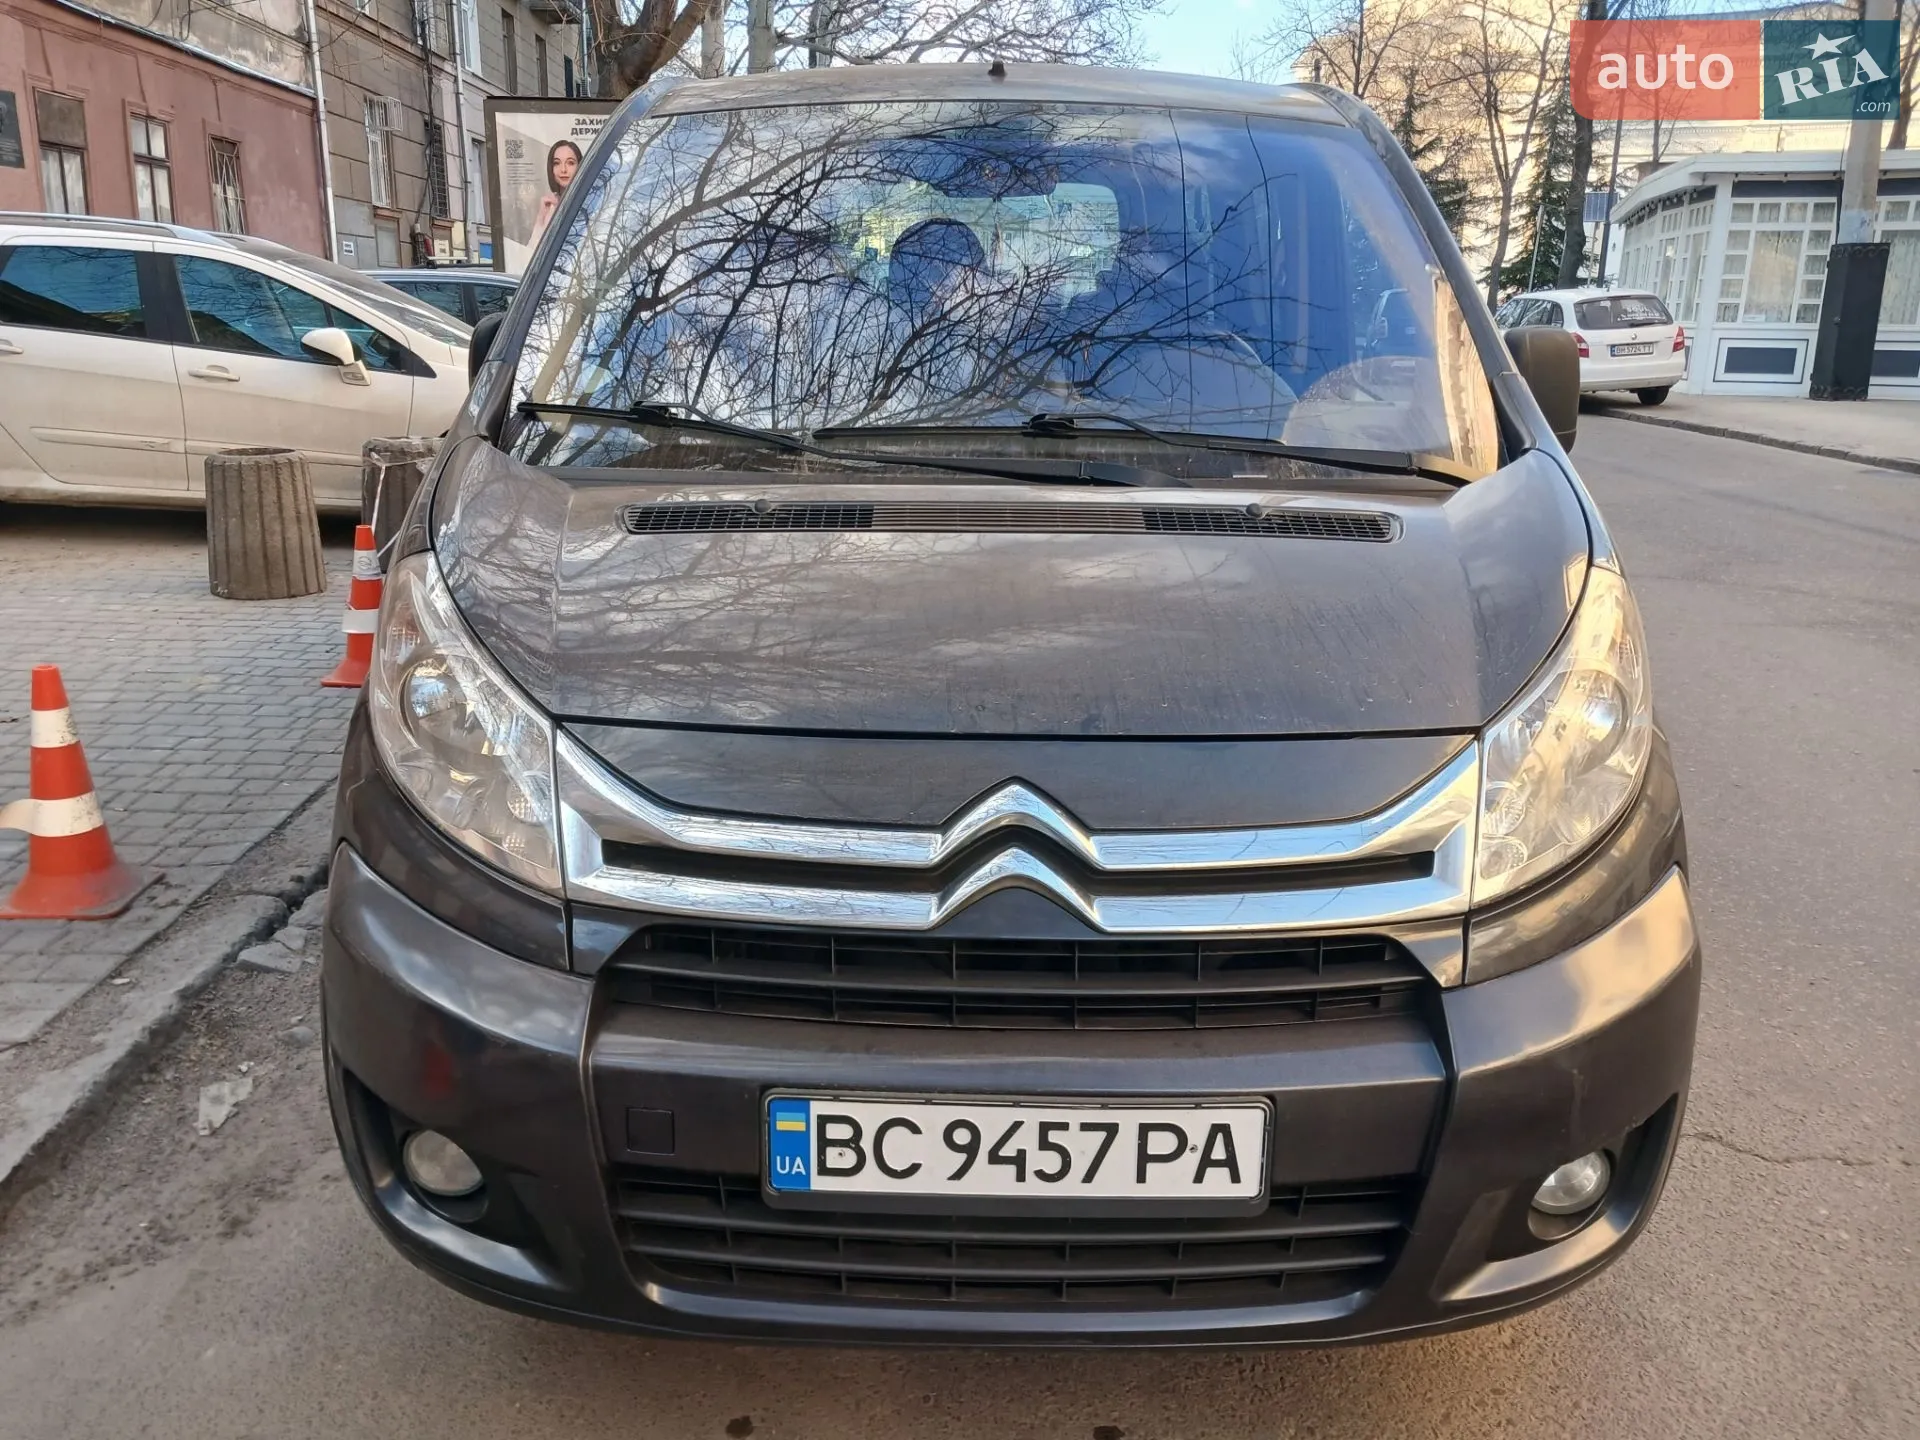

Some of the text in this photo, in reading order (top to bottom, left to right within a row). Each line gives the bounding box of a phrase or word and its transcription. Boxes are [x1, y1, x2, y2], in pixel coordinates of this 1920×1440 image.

[776, 1156, 806, 1176] UA
[816, 1113, 1242, 1184] BC 9457 PA
